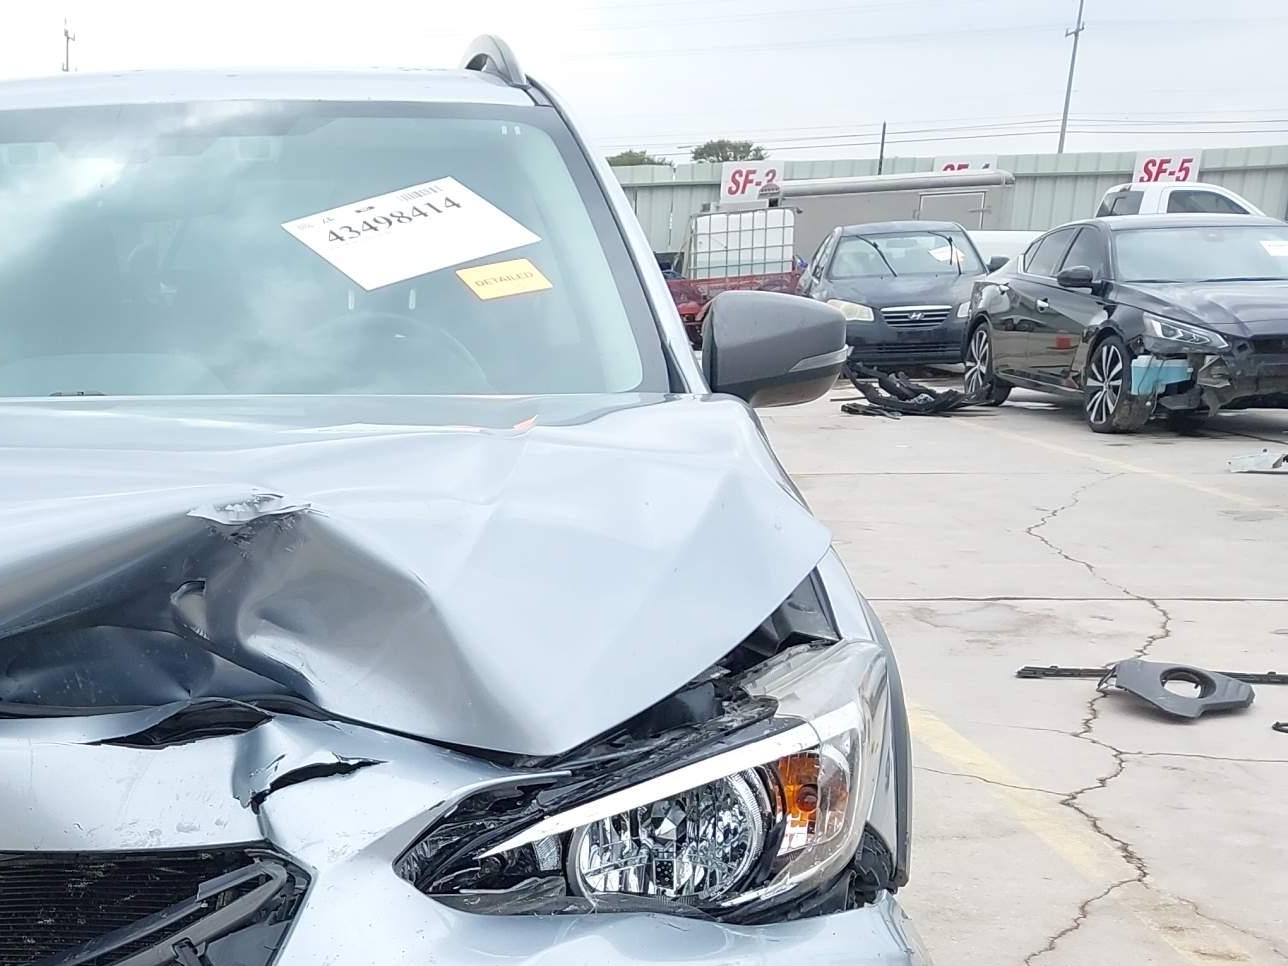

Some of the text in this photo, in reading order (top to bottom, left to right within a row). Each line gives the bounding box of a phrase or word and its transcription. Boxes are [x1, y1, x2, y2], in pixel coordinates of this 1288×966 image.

[1139, 158, 1193, 183] SF-5
[328, 196, 462, 242] 43498414
[474, 270, 534, 287] DETAILED
